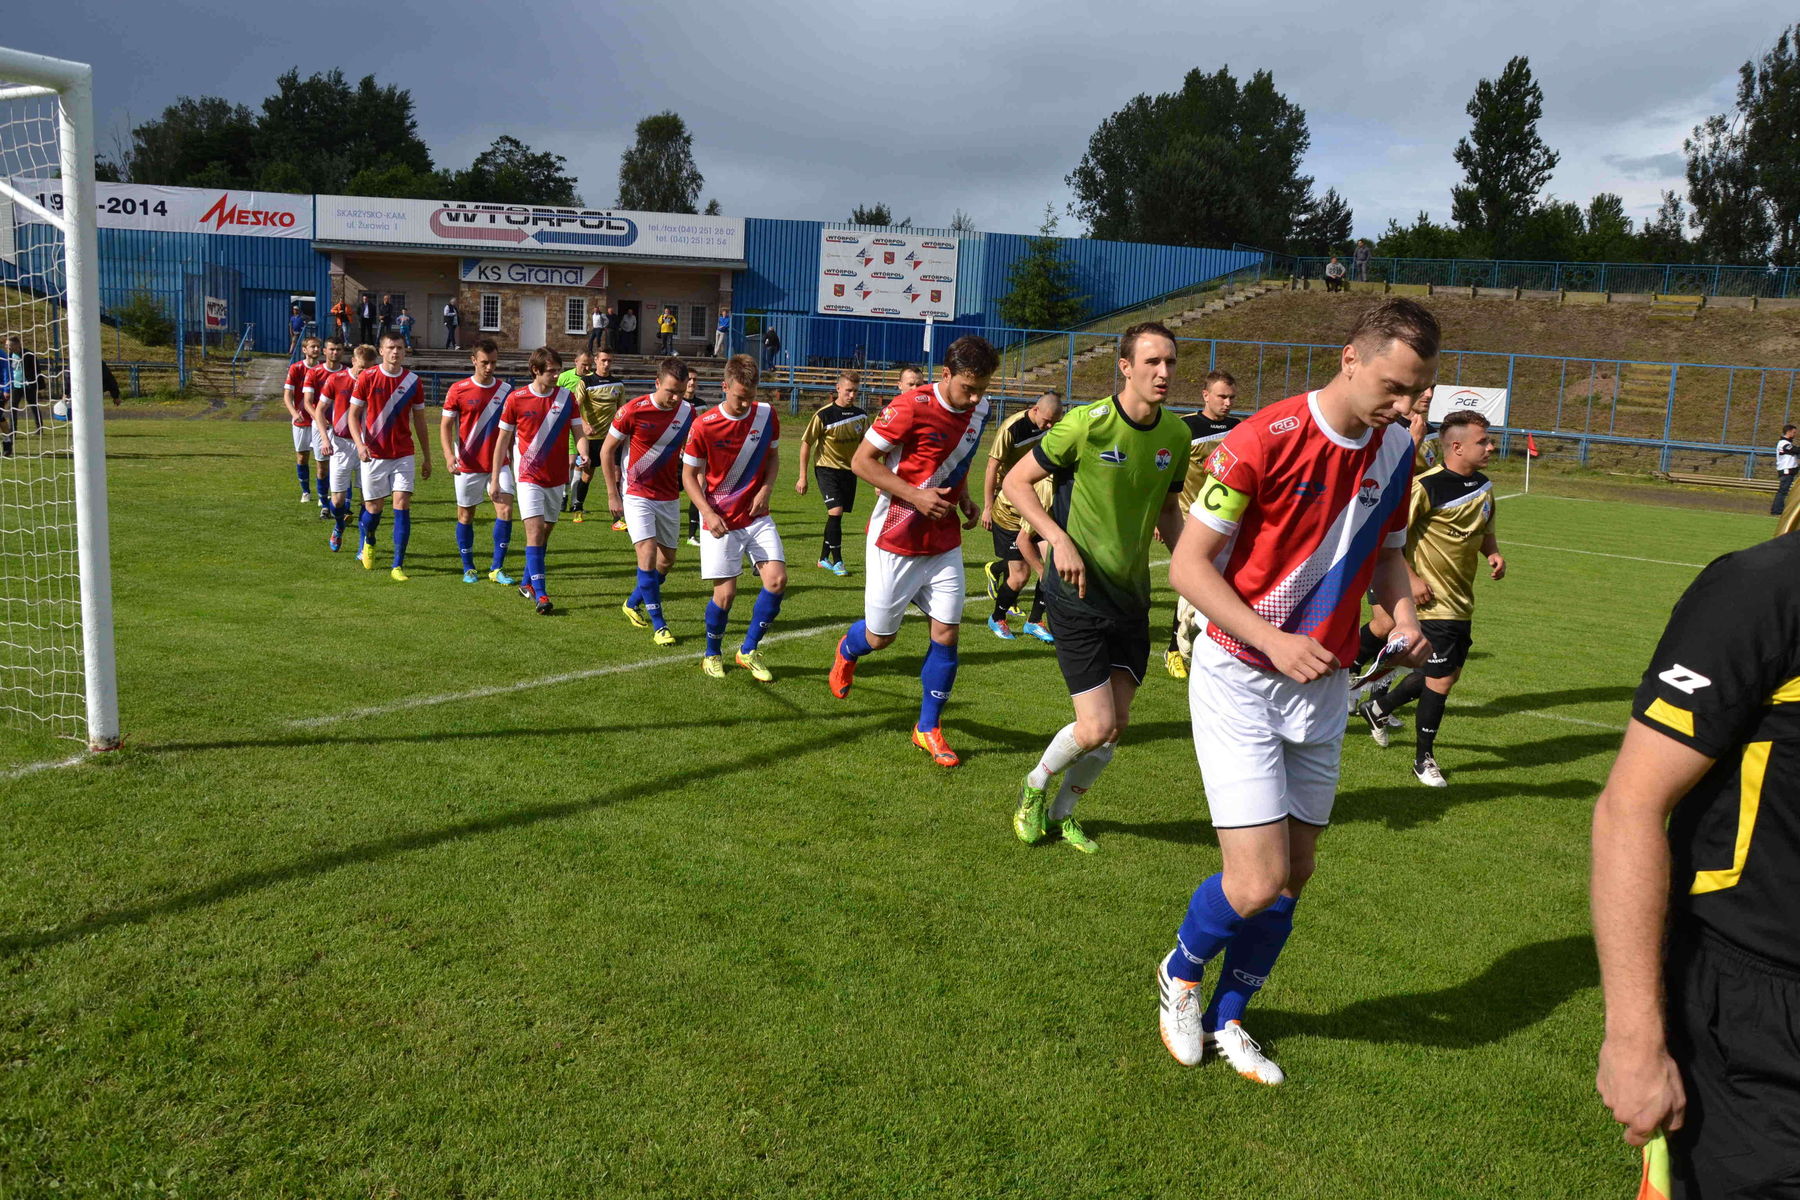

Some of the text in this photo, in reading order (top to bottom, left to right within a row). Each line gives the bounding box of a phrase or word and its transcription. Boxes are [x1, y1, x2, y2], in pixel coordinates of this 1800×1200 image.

[199, 192, 296, 232] MESKO
[699, 226, 712, 235] 251
[725, 227, 736, 236] 02
[670, 234, 689, 245] (041)
[691, 236, 703, 245] 251
[705, 237, 714, 246] 21
[478, 263, 584, 285] KS Granat
[1455, 397, 1479, 407] PGE
[1204, 483, 1229, 511] C
